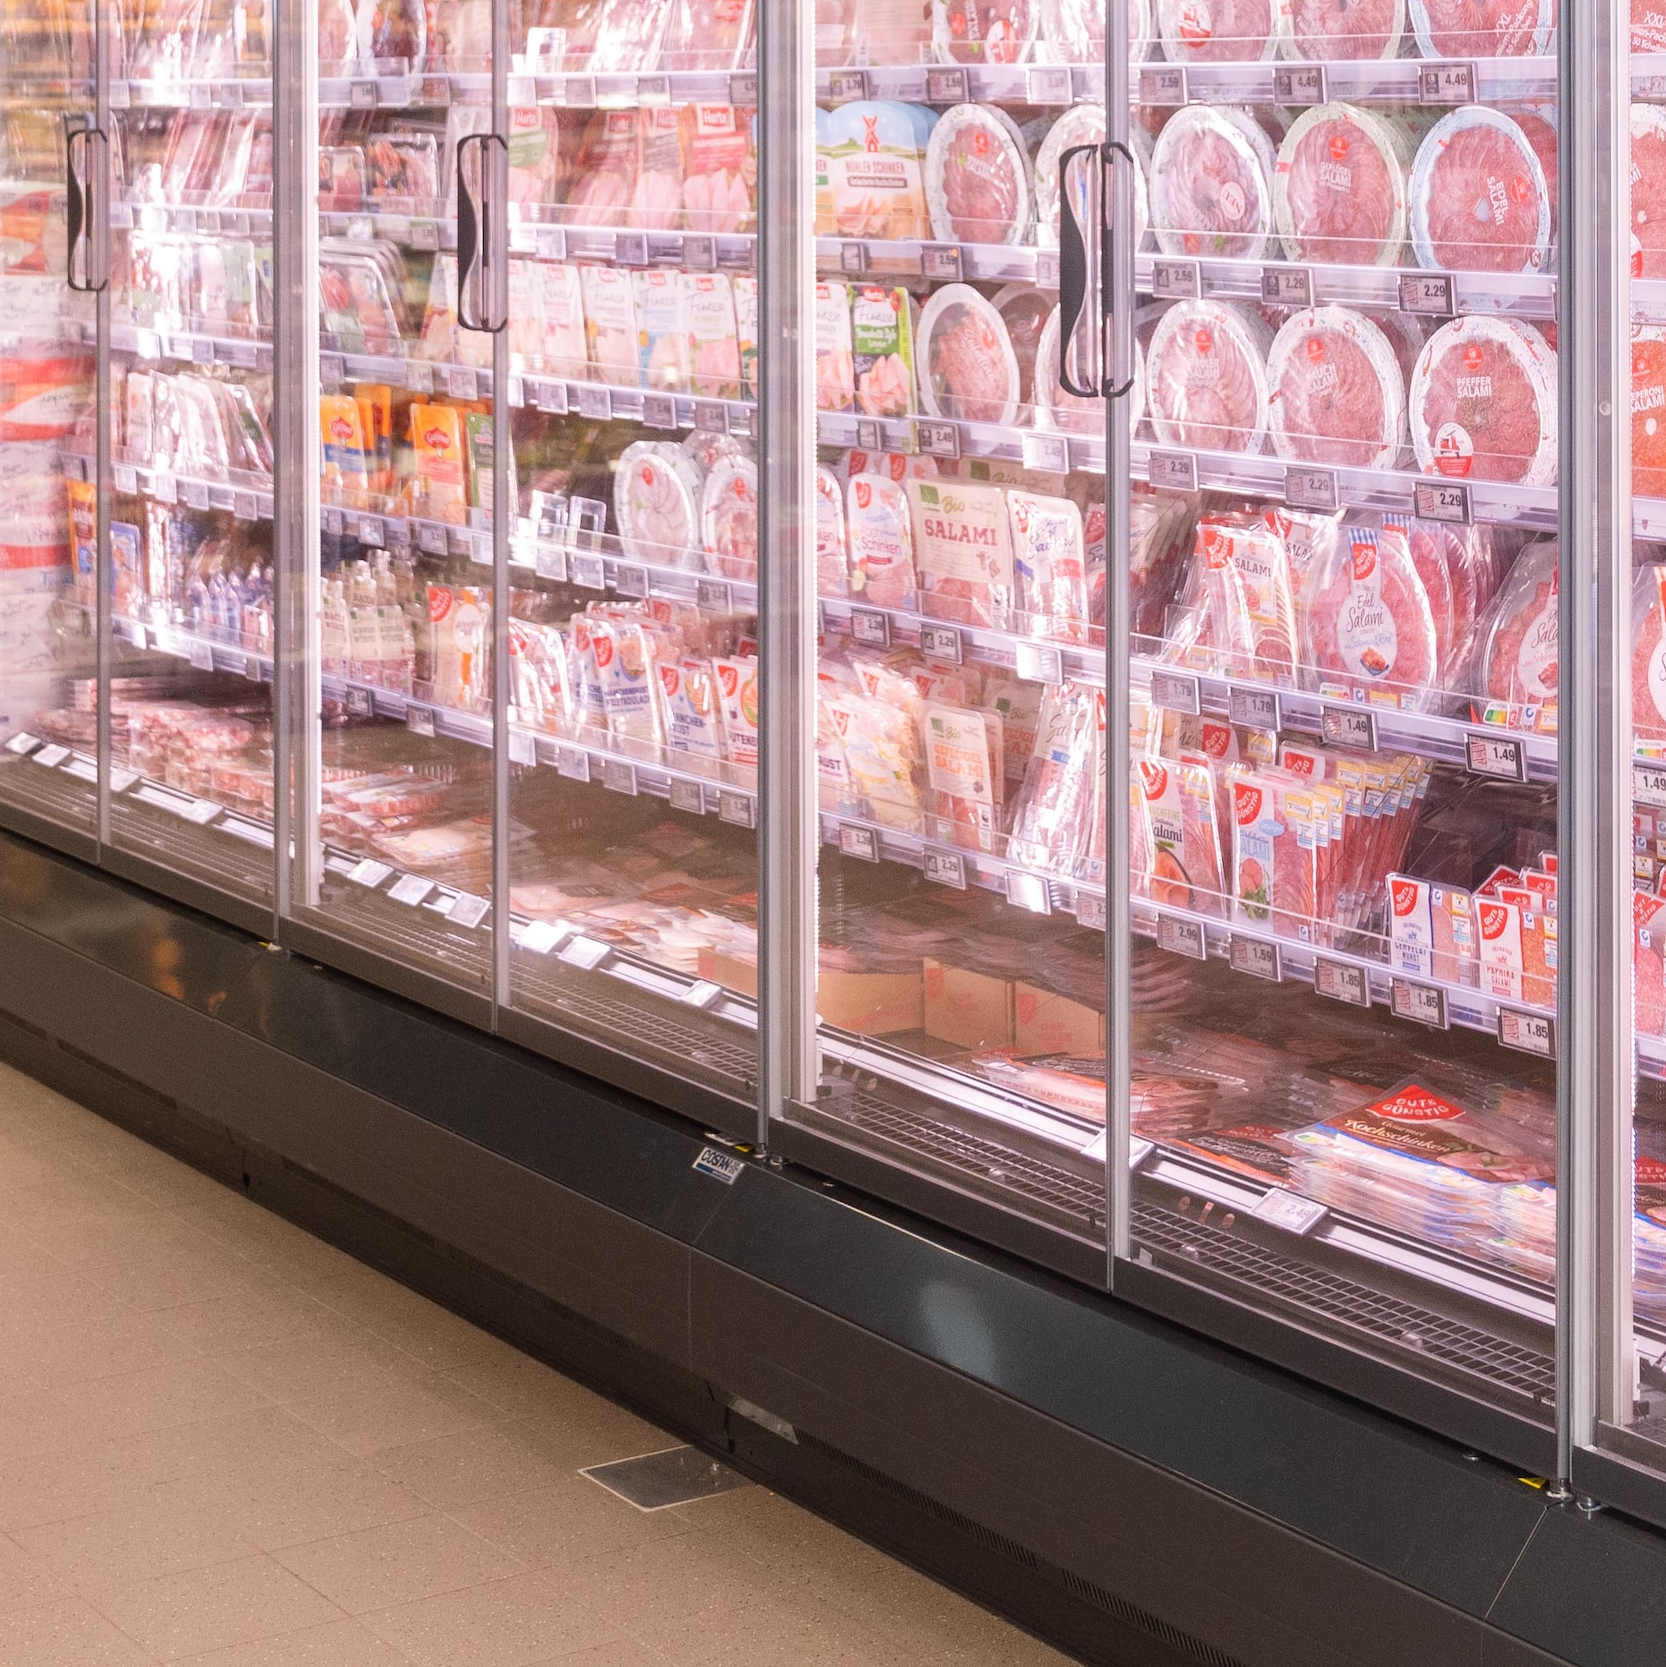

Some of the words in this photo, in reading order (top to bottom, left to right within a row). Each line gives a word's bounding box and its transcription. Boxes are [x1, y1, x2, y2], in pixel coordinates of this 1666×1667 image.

[1643, 11, 1664, 29] XXL
[1298, 75, 1318, 88] 4.49
[1446, 73, 1467, 86] 4.49
[1319, 169, 1352, 188] SALAMI
[1486, 175, 1505, 225] SALAMI
[1496, 181, 1509, 213] EDEL
[1285, 277, 1304, 289] 2.29
[1424, 284, 1446, 297] 2.29
[1456, 376, 1491, 386] PFEFFER
[1457, 385, 1492, 399] SALAMI
[1631, 393, 1666, 413] SALAMI
[1171, 460, 1189, 474] 2.29
[1309, 478, 1329, 492] 2.29
[942, 494, 965, 514] Bio
[1440, 492, 1462, 507] 2.29
[925, 518, 998, 547] SALAMI
[1235, 557, 1271, 578] SALAMI
[1357, 590, 1374, 609] Edel
[1346, 607, 1384, 633] Salami
[1173, 683, 1192, 697] 1.79
[1252, 699, 1271, 713] 1.79
[1346, 719, 1368, 733] 1.49
[1492, 747, 1515, 763] 1.49
[1253, 947, 1272, 962] 1.59
[1340, 971, 1360, 988] 1.85
[1418, 992, 1438, 1008] 1.85
[1526, 1022, 1548, 1039] 1.85
[1382, 1104, 1450, 1117] GÜNSTIG
[1380, 1120, 1426, 1136] Gourmet
[1344, 1119, 1451, 1154] Kochschinken
